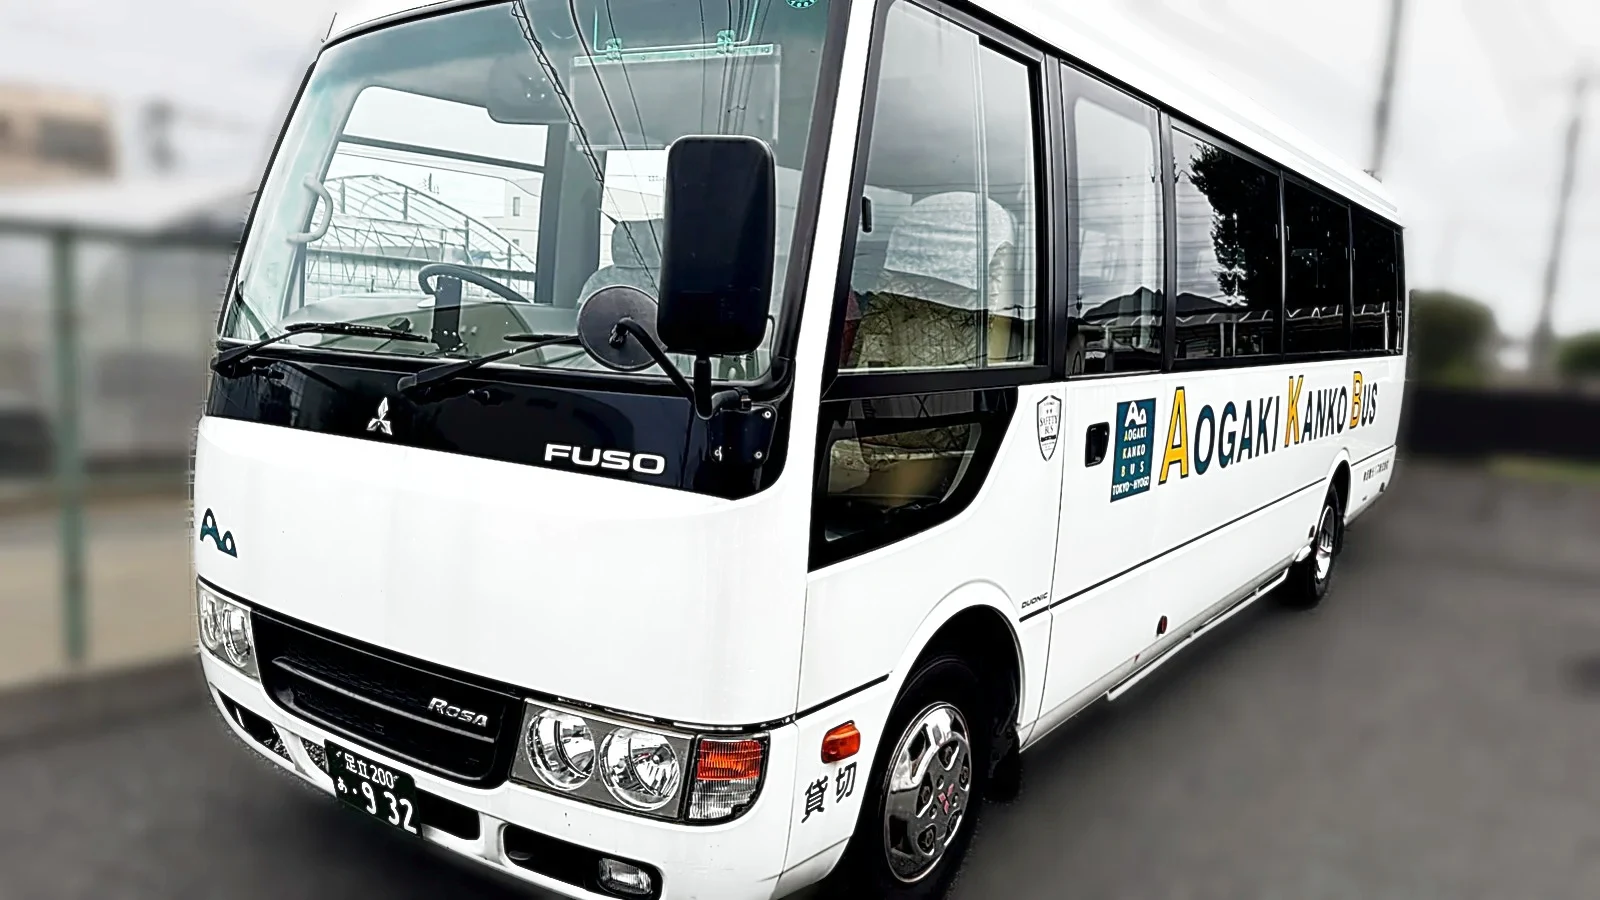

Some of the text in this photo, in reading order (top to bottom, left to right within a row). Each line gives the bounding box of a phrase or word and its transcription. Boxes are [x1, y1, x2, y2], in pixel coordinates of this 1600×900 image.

[1124, 426, 1147, 442] AOGAKI
[1158, 371, 1378, 485] AOGAKI KANKO BUS
[544, 443, 665, 475] FUSO
[1122, 444, 1146, 459] KANKO
[1121, 461, 1145, 477] BUS
[801, 761, 857, 823] 貸切
